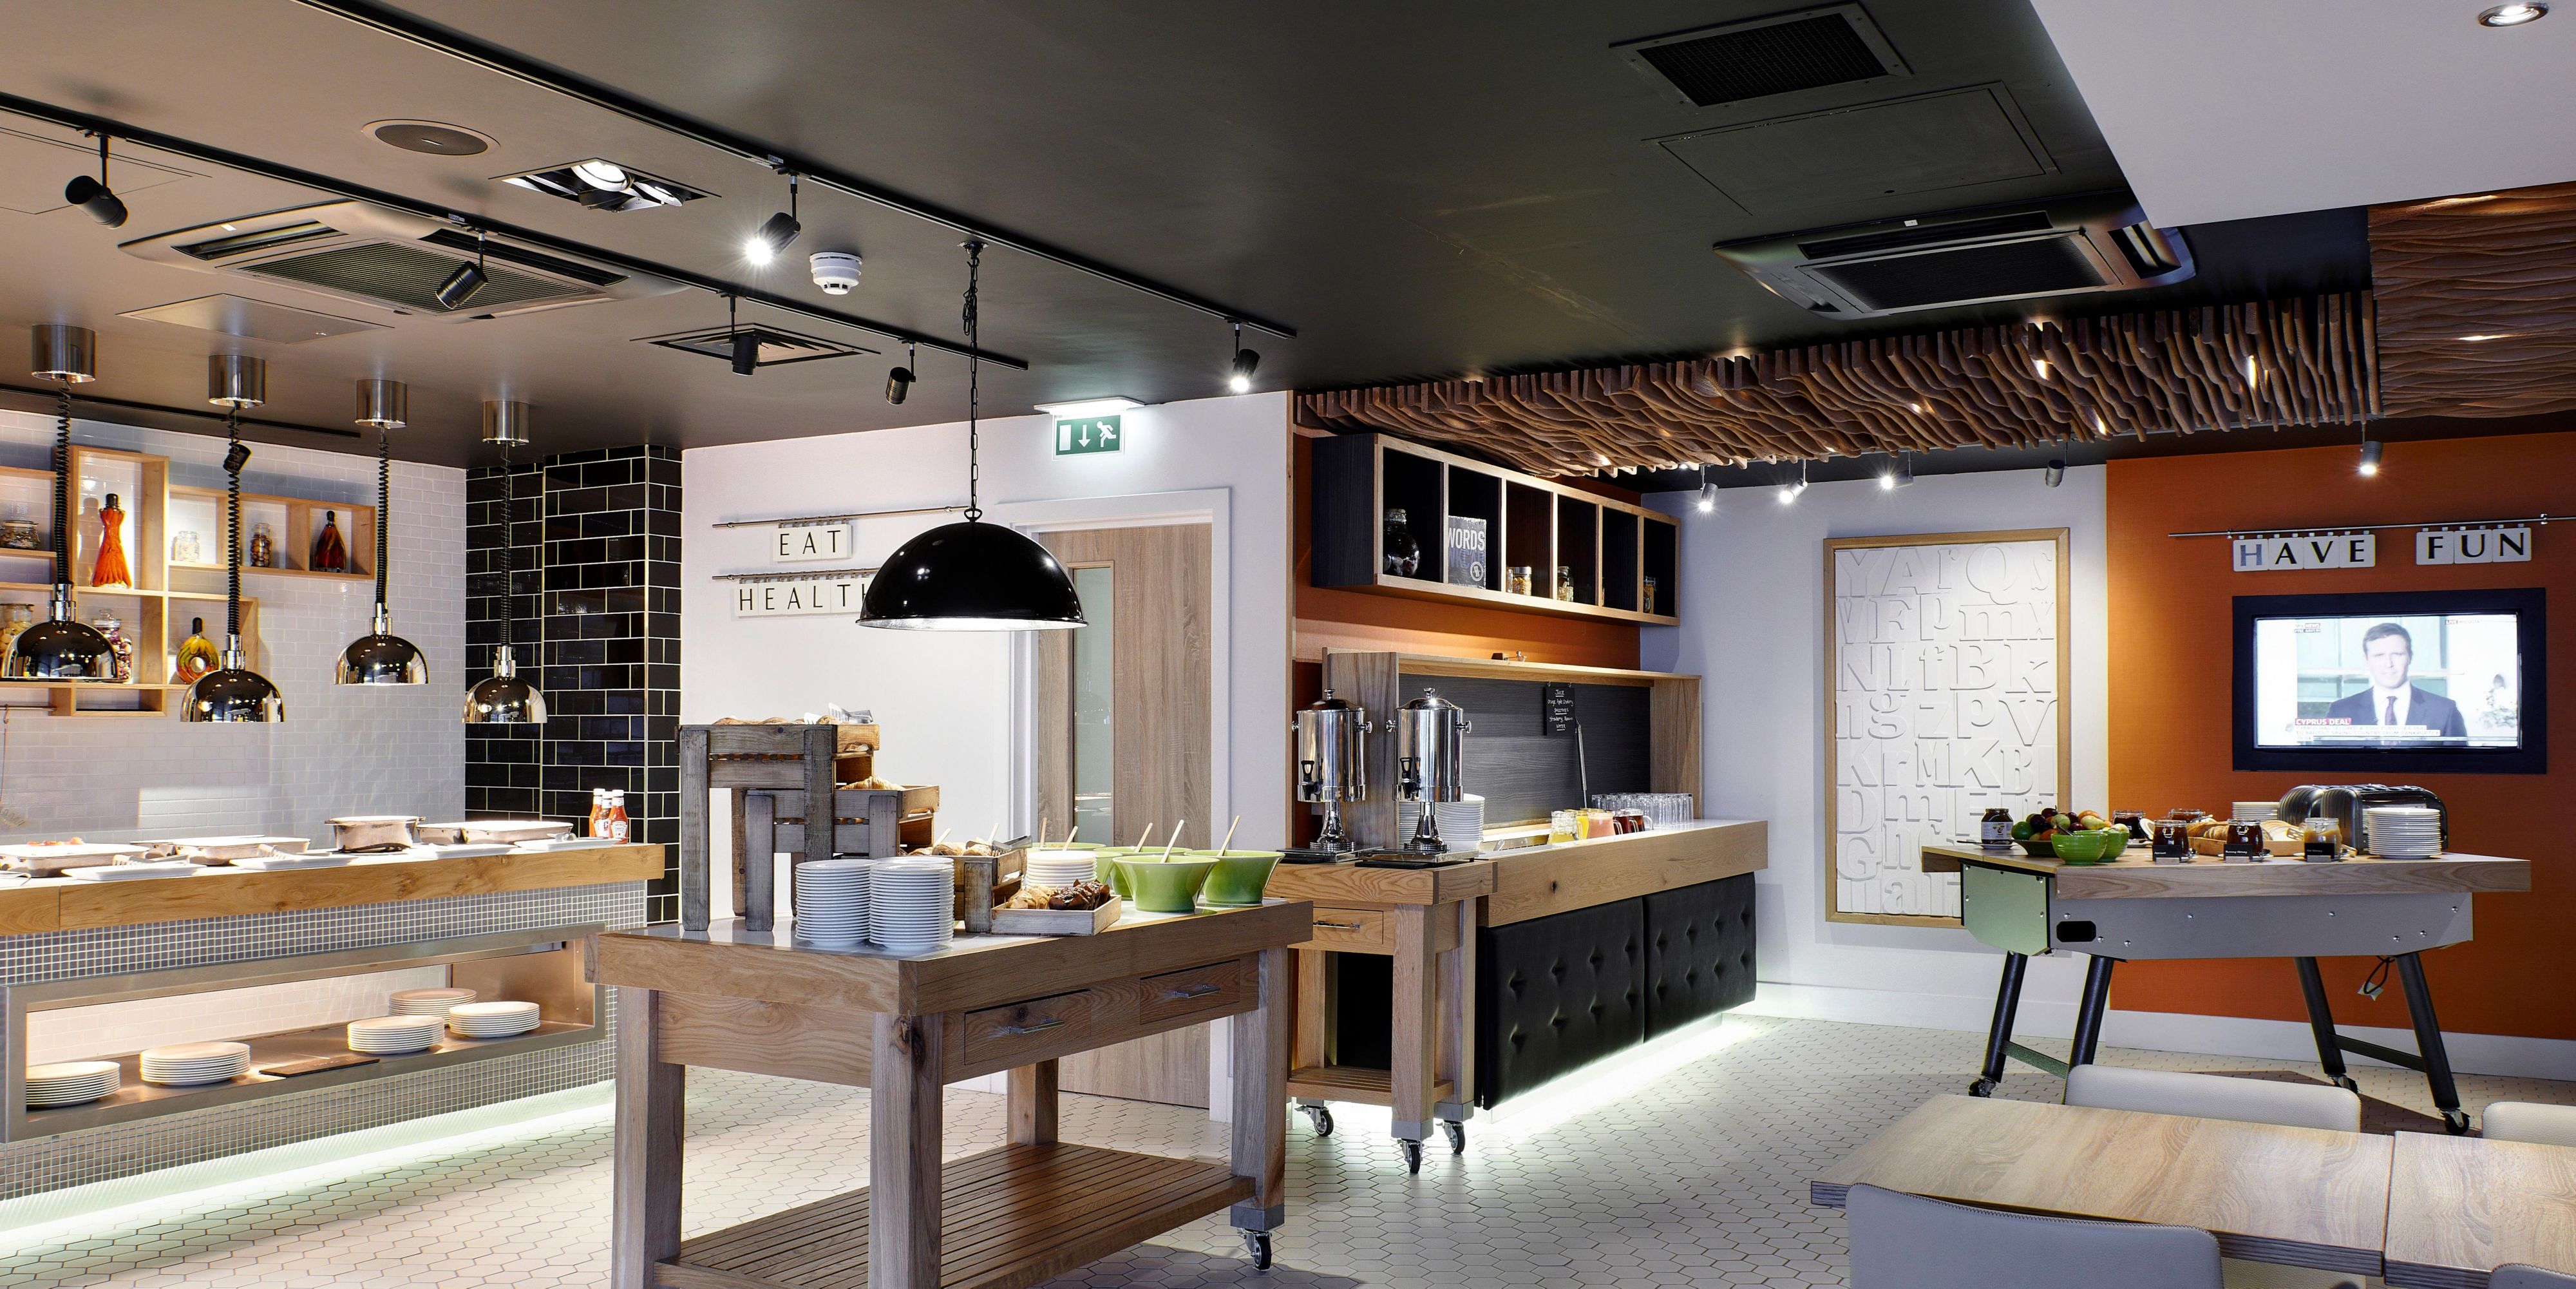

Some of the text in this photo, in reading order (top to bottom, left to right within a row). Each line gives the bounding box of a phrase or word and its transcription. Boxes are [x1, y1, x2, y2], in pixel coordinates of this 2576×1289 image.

[779, 530, 841, 557] EAT
[1448, 527, 1485, 551] WORDS
[2240, 532, 2524, 567] HAVE FUN
